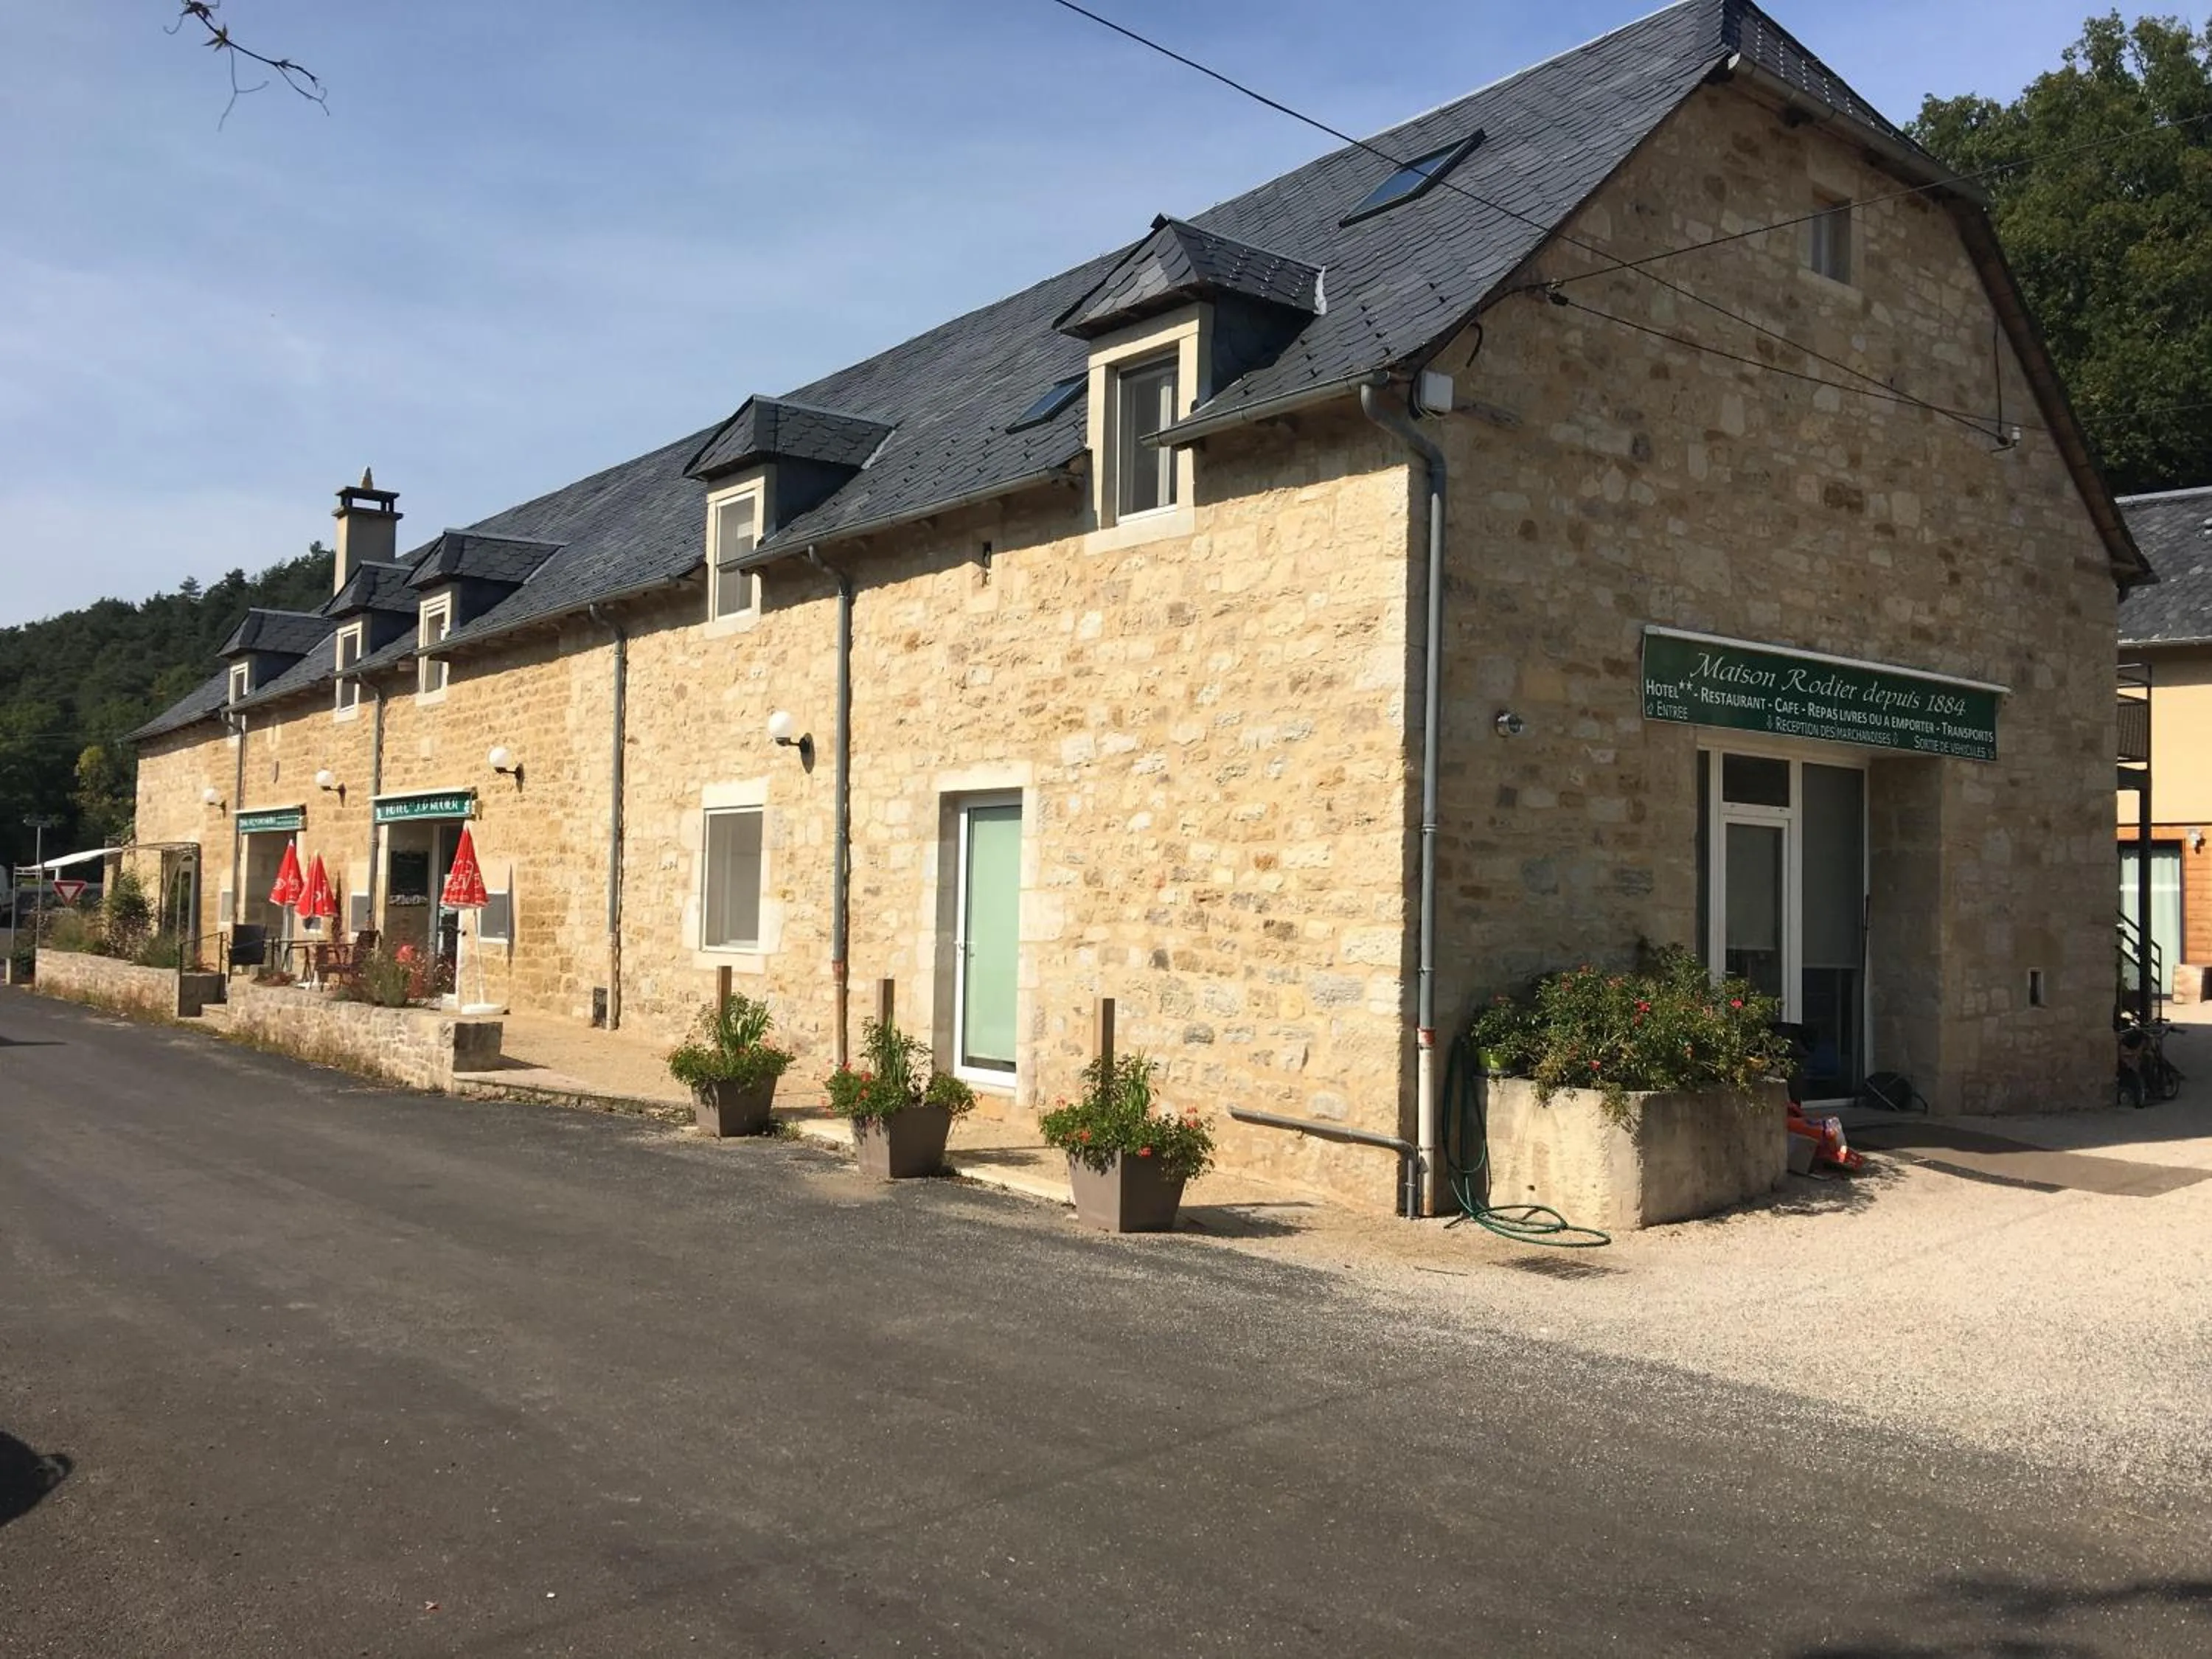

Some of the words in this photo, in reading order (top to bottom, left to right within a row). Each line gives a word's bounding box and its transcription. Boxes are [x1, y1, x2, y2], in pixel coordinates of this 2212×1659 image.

[1690, 653, 1775, 687] Maison
[1781, 668, 1857, 700] Rodier
[1863, 681, 1919, 712] depuis
[1925, 695, 1966, 717] 1884
[1657, 701, 1688, 720] ENTREE
[1701, 686, 1766, 711] RESTAURANT
[1775, 698, 1799, 715] CAFE
[1808, 702, 1837, 720] REPAS
[1840, 709, 1868, 725] LIVRES
[1869, 713, 1882, 726] OU
[1884, 714, 1890, 727] A
[1891, 716, 1935, 734] EMPORTER
[1942, 722, 1994, 742] TRANSPORTS
[1775, 716, 1818, 736] RECEPTION
[1821, 725, 1835, 737] DES
[1837, 728, 1891, 745] MARCHANDISES
